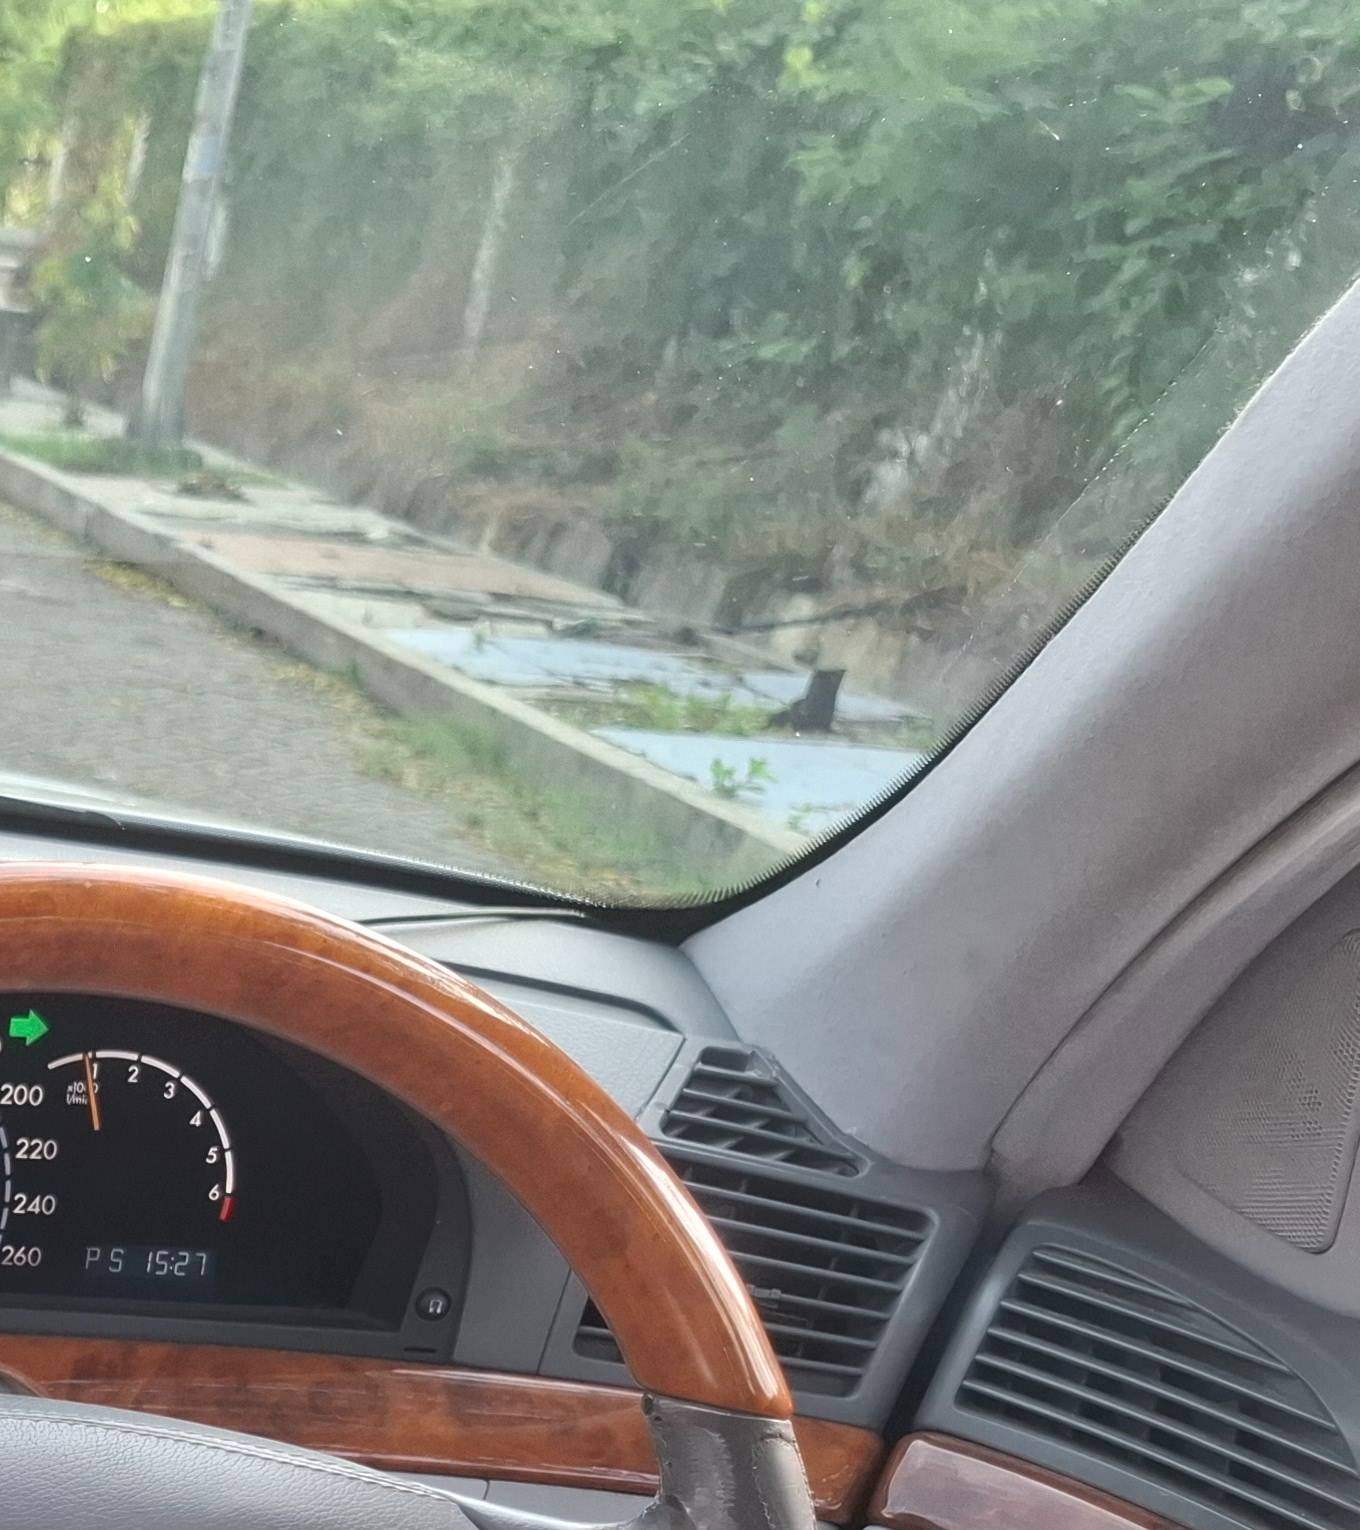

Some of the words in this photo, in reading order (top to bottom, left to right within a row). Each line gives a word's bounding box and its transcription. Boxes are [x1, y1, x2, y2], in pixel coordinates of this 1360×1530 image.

[92, 1063, 99, 1078] 1
[127, 1065, 139, 1083] 2
[0, 1083, 43, 1107] 200
[163, 1082, 175, 1099] 3
[189, 1110, 202, 1127] 4
[15, 1138, 58, 1160] 220
[206, 1147, 218, 1164] 5
[208, 1184, 220, 1201] 6
[13, 1193, 56, 1215] 240
[1, 1245, 42, 1267] 260
[85, 1247, 100, 1270] P
[146, 1250, 207, 1276] 15:27
